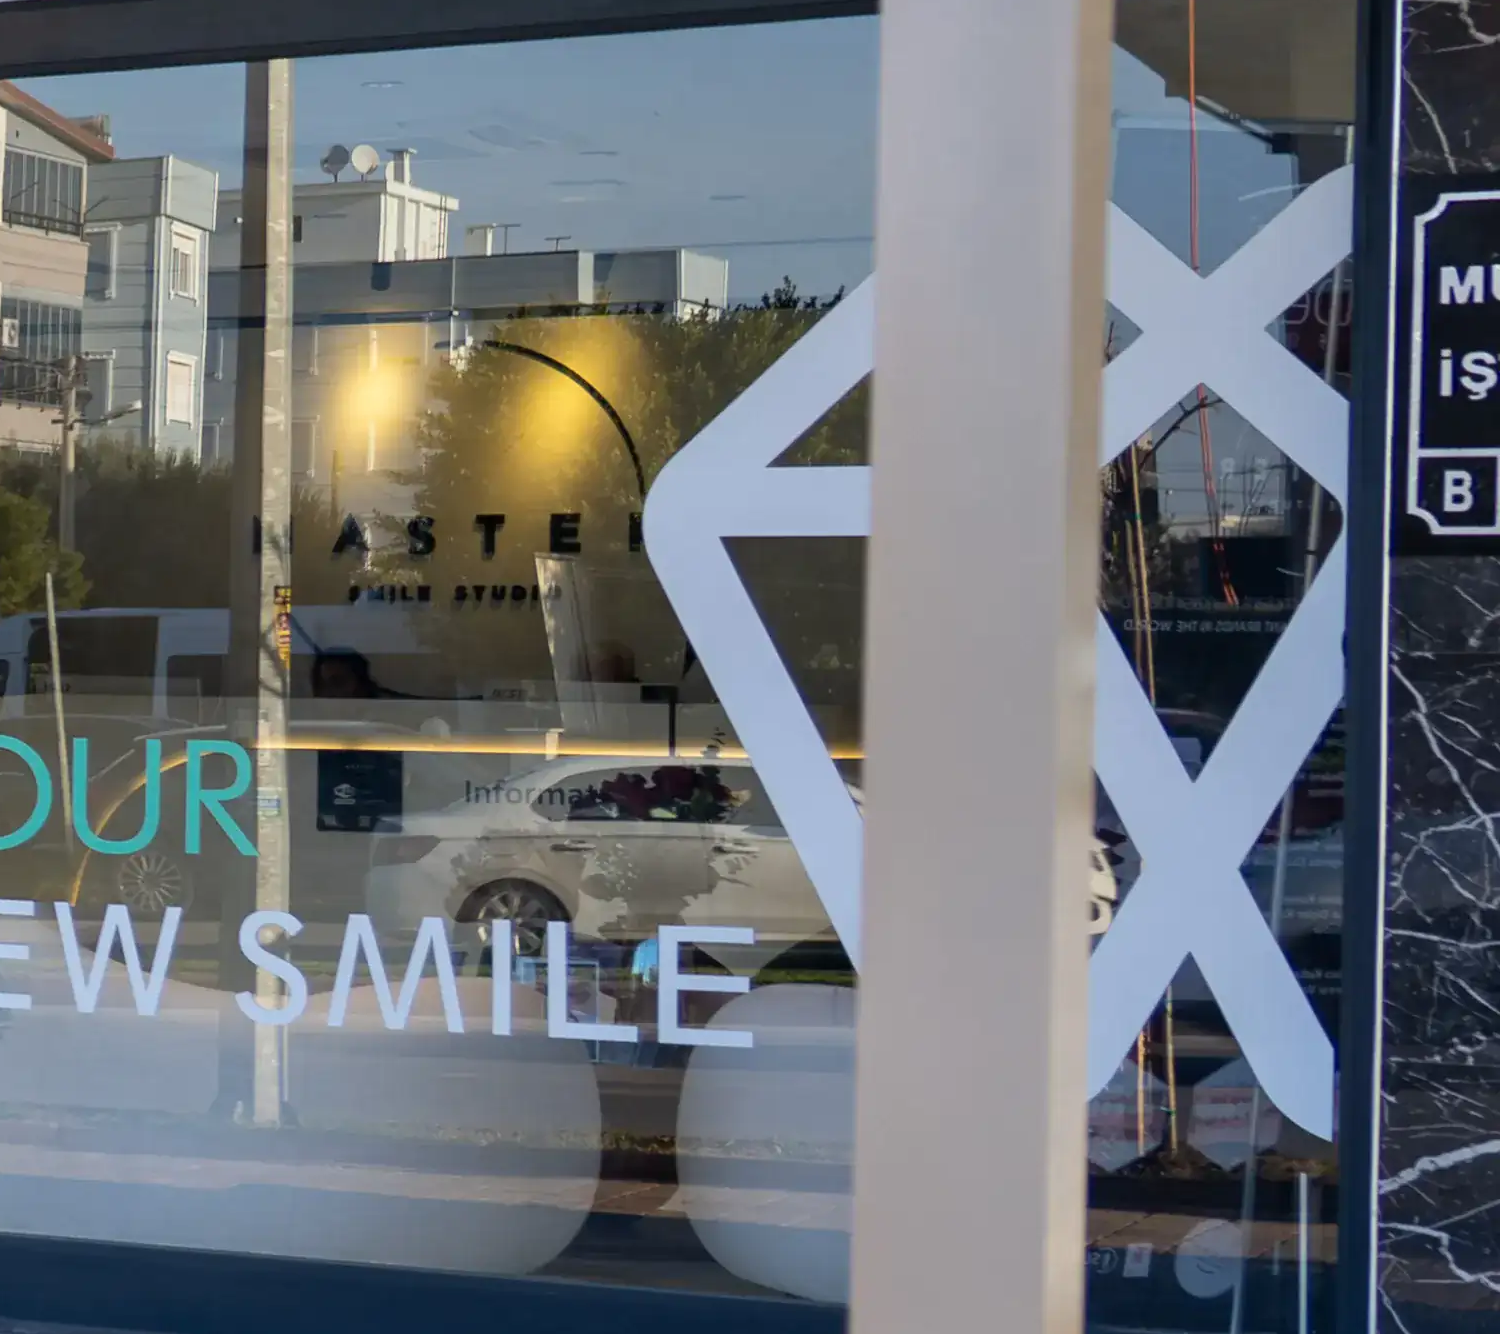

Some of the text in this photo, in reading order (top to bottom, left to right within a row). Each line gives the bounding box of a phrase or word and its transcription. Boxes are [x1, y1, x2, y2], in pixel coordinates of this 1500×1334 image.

[1439, 253, 1500, 305] M
[1439, 349, 1500, 400] İŞ
[1443, 470, 1474, 512] B
[349, 584, 432, 604] SMILE
[235, 910, 755, 1049] SMILE
